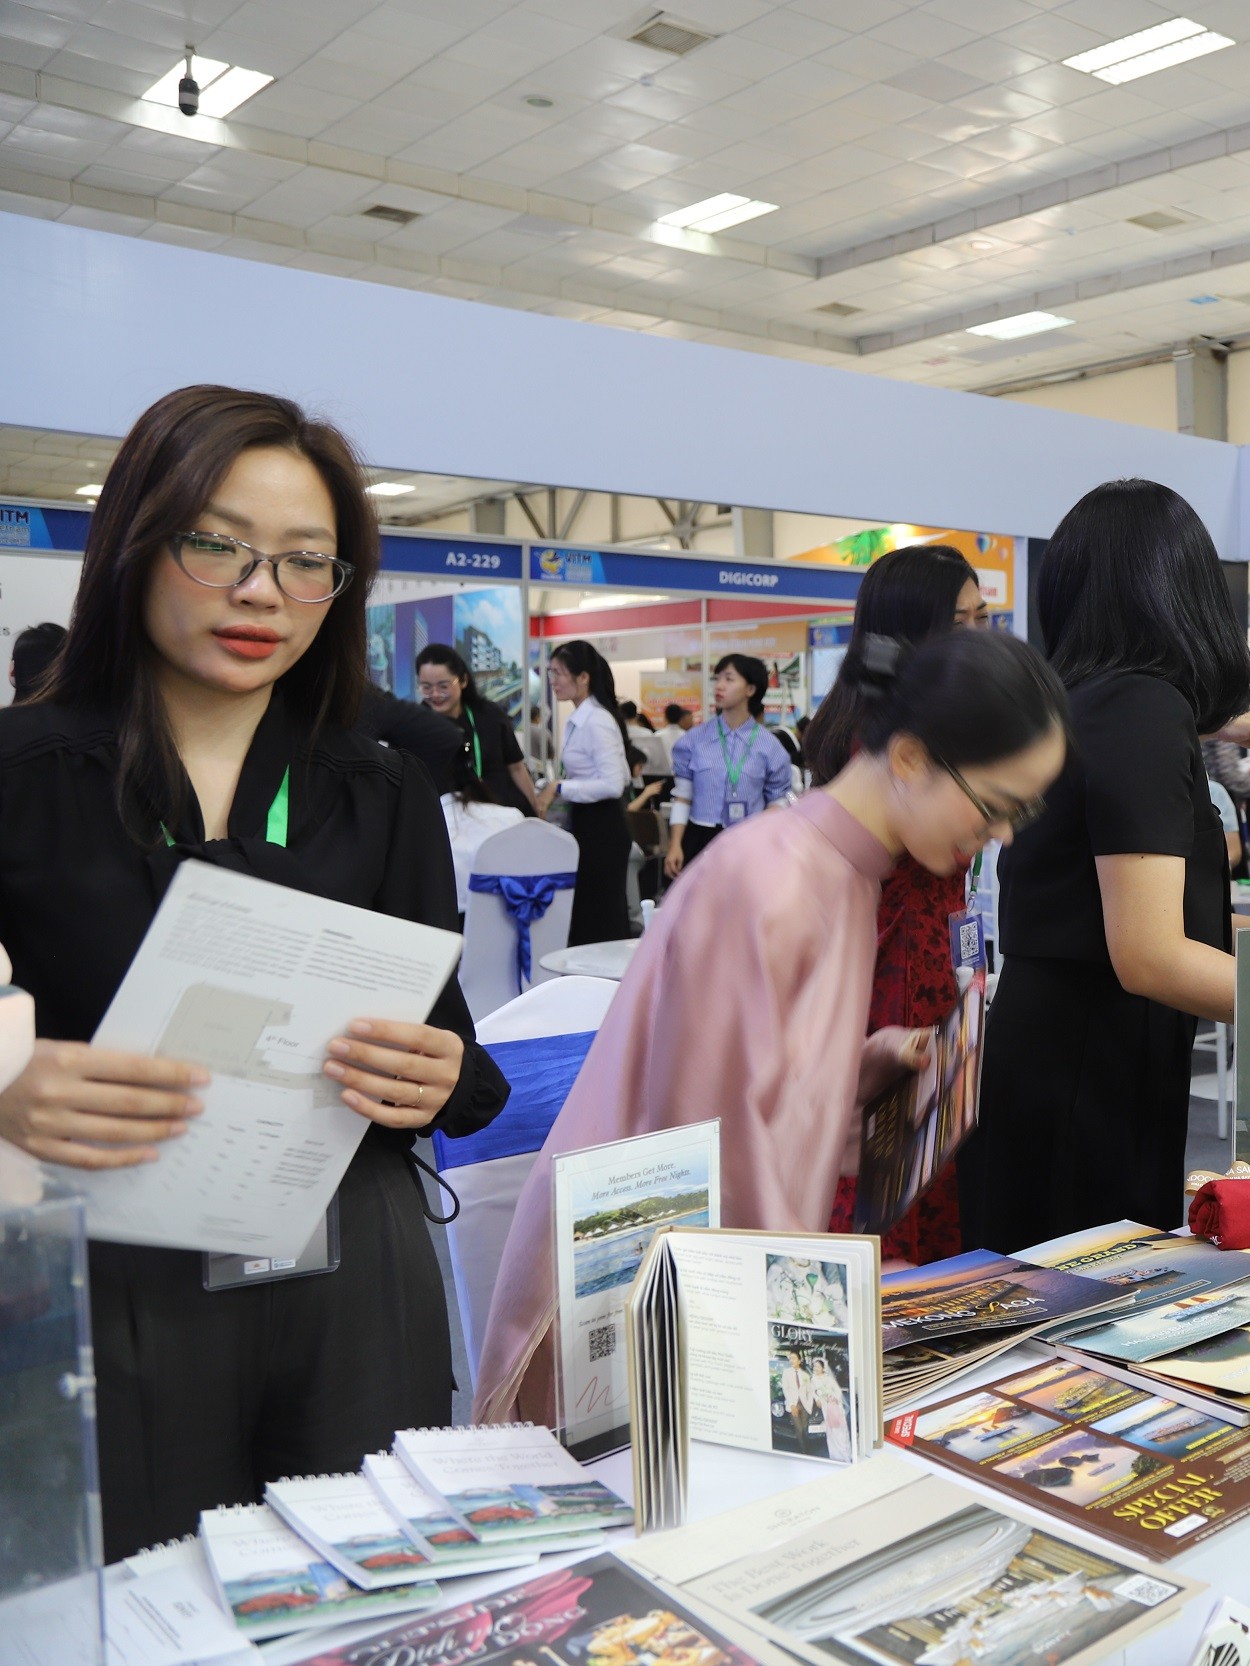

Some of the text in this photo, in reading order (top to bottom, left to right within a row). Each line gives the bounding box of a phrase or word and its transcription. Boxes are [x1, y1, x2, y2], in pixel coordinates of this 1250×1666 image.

[0, 509, 29, 524] ITM
[445, 551, 501, 569] A2-229
[719, 570, 779, 588] DIGICORP
[592, 1169, 691, 1201] More Access. More Free Nights.
[608, 1162, 676, 1186] Members Get More.
[882, 1310, 977, 1330] MEKONG
[771, 1325, 814, 1342] GLORY
[901, 1414, 915, 1438] SPECIAL
[1112, 1471, 1215, 1522] SPECIAL
[1140, 1486, 1224, 1531] OFFER
